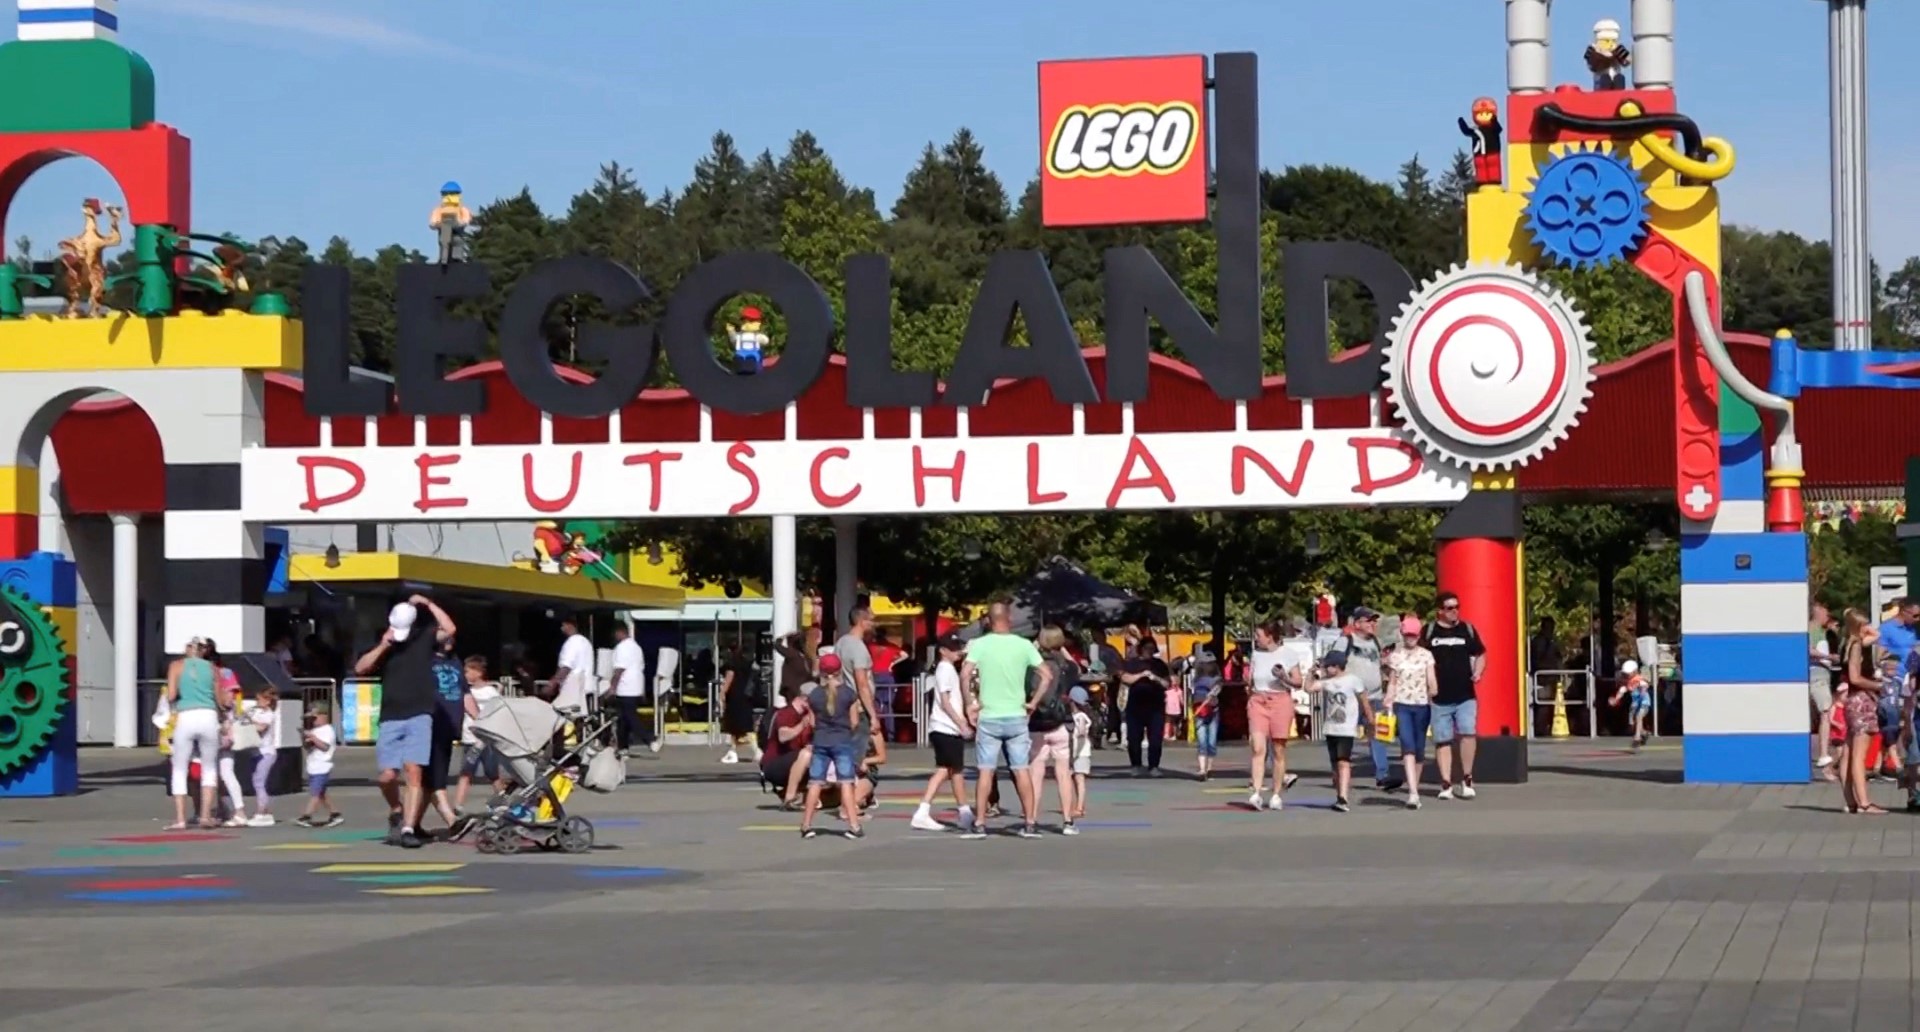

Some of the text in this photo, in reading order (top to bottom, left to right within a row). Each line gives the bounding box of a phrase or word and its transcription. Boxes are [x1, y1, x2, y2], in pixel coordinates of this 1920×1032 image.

[1052, 106, 1193, 172] LEGO
[303, 52, 1417, 418] LEGOLAND
[297, 435, 1423, 514] DEUTSCHLAND
